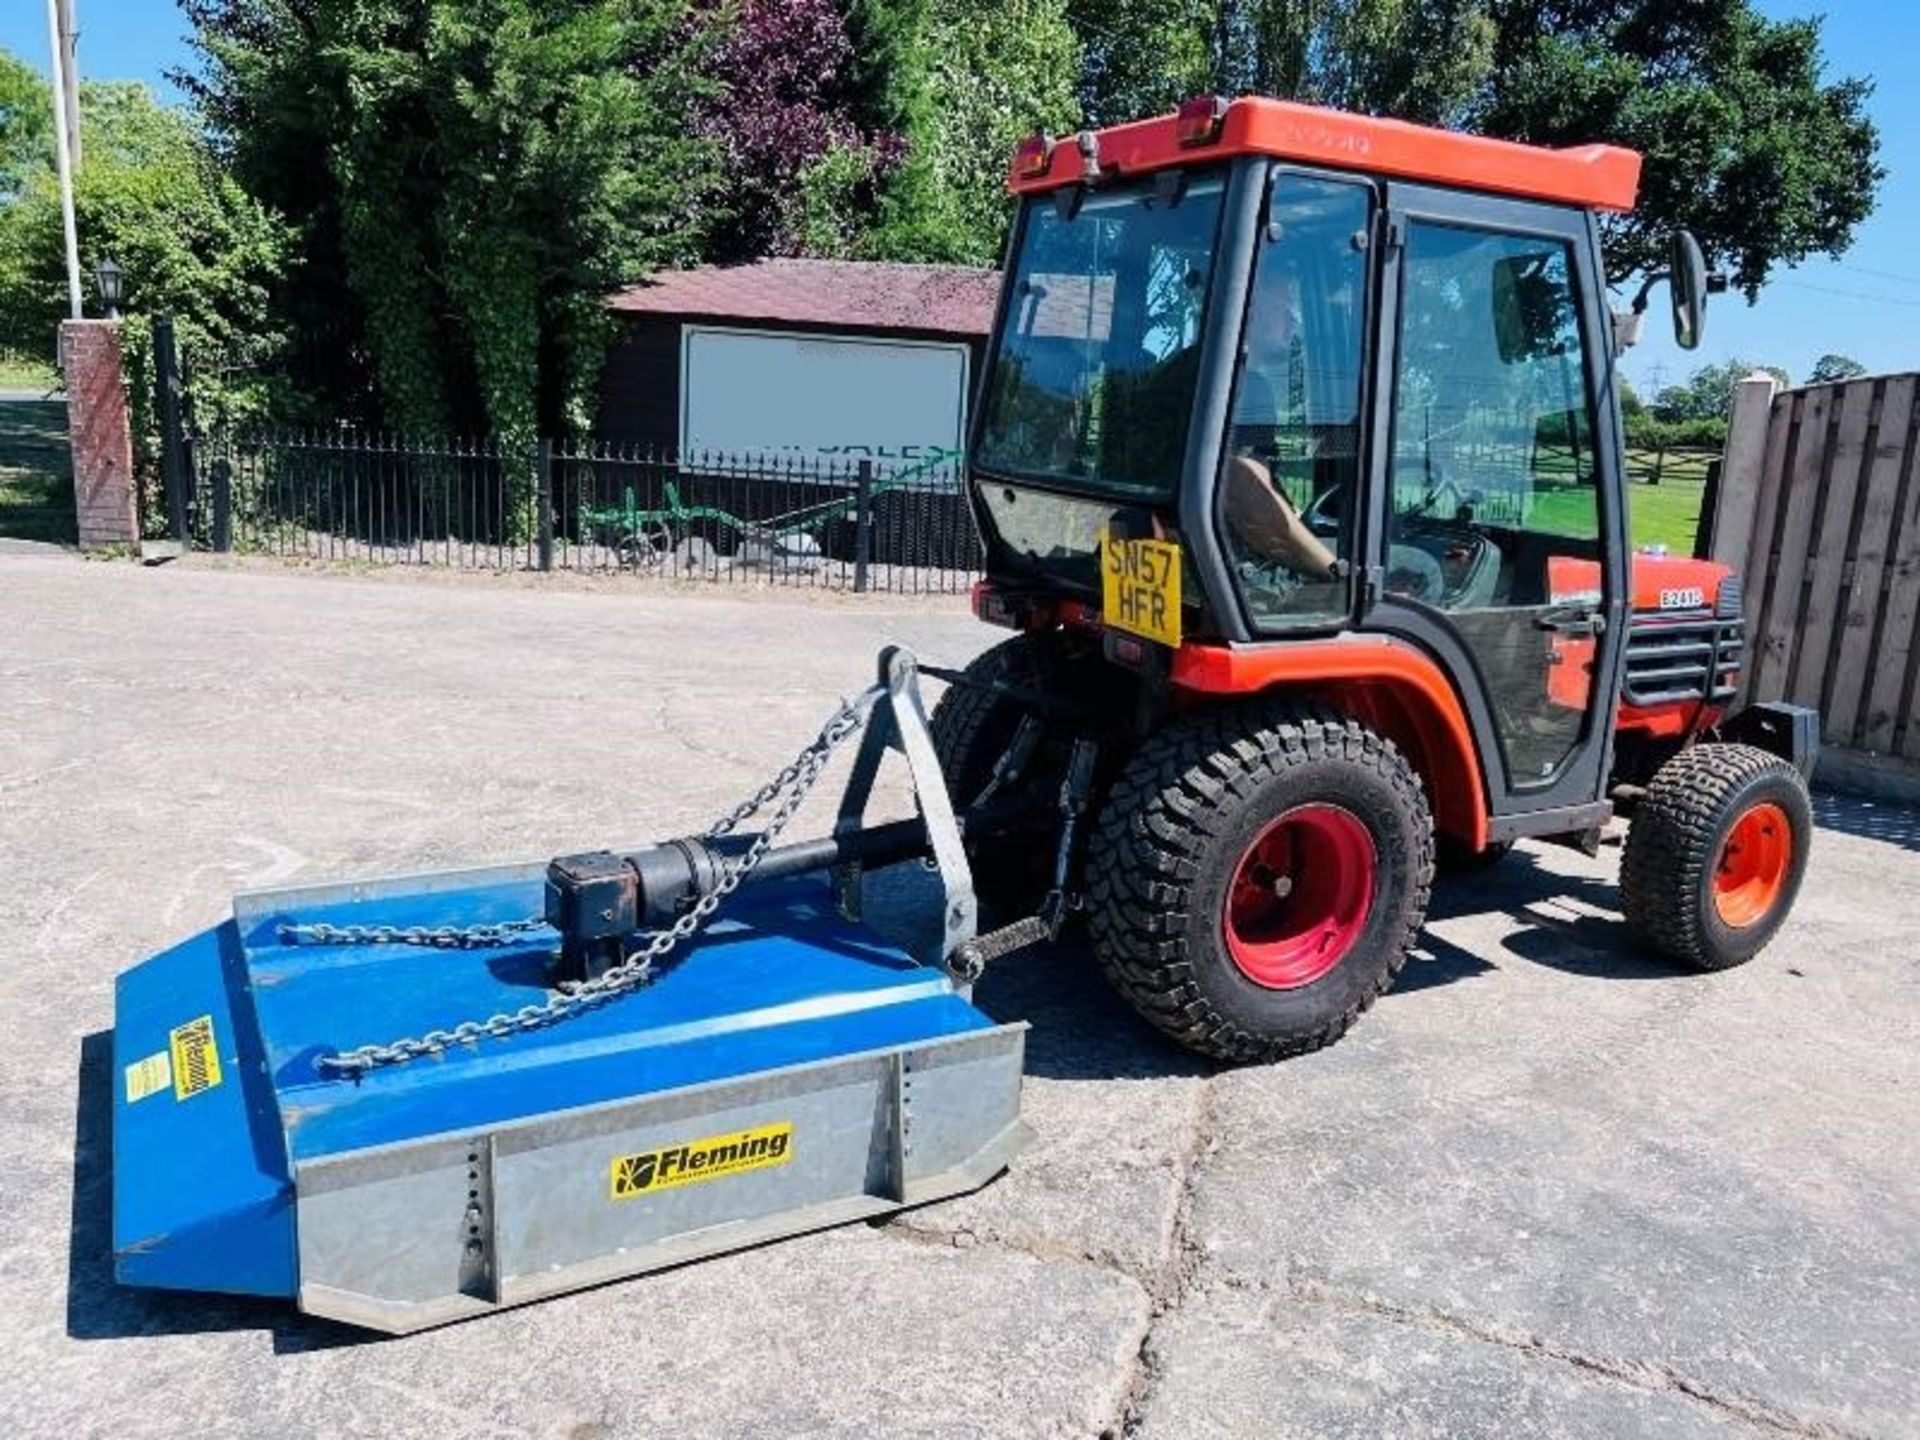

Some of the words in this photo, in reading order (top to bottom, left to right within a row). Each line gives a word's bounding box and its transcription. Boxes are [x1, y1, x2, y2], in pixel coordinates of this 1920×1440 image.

[1109, 540, 1171, 588] SN57
[1119, 576, 1165, 632] HFR
[657, 1133, 788, 1176] Fleming
